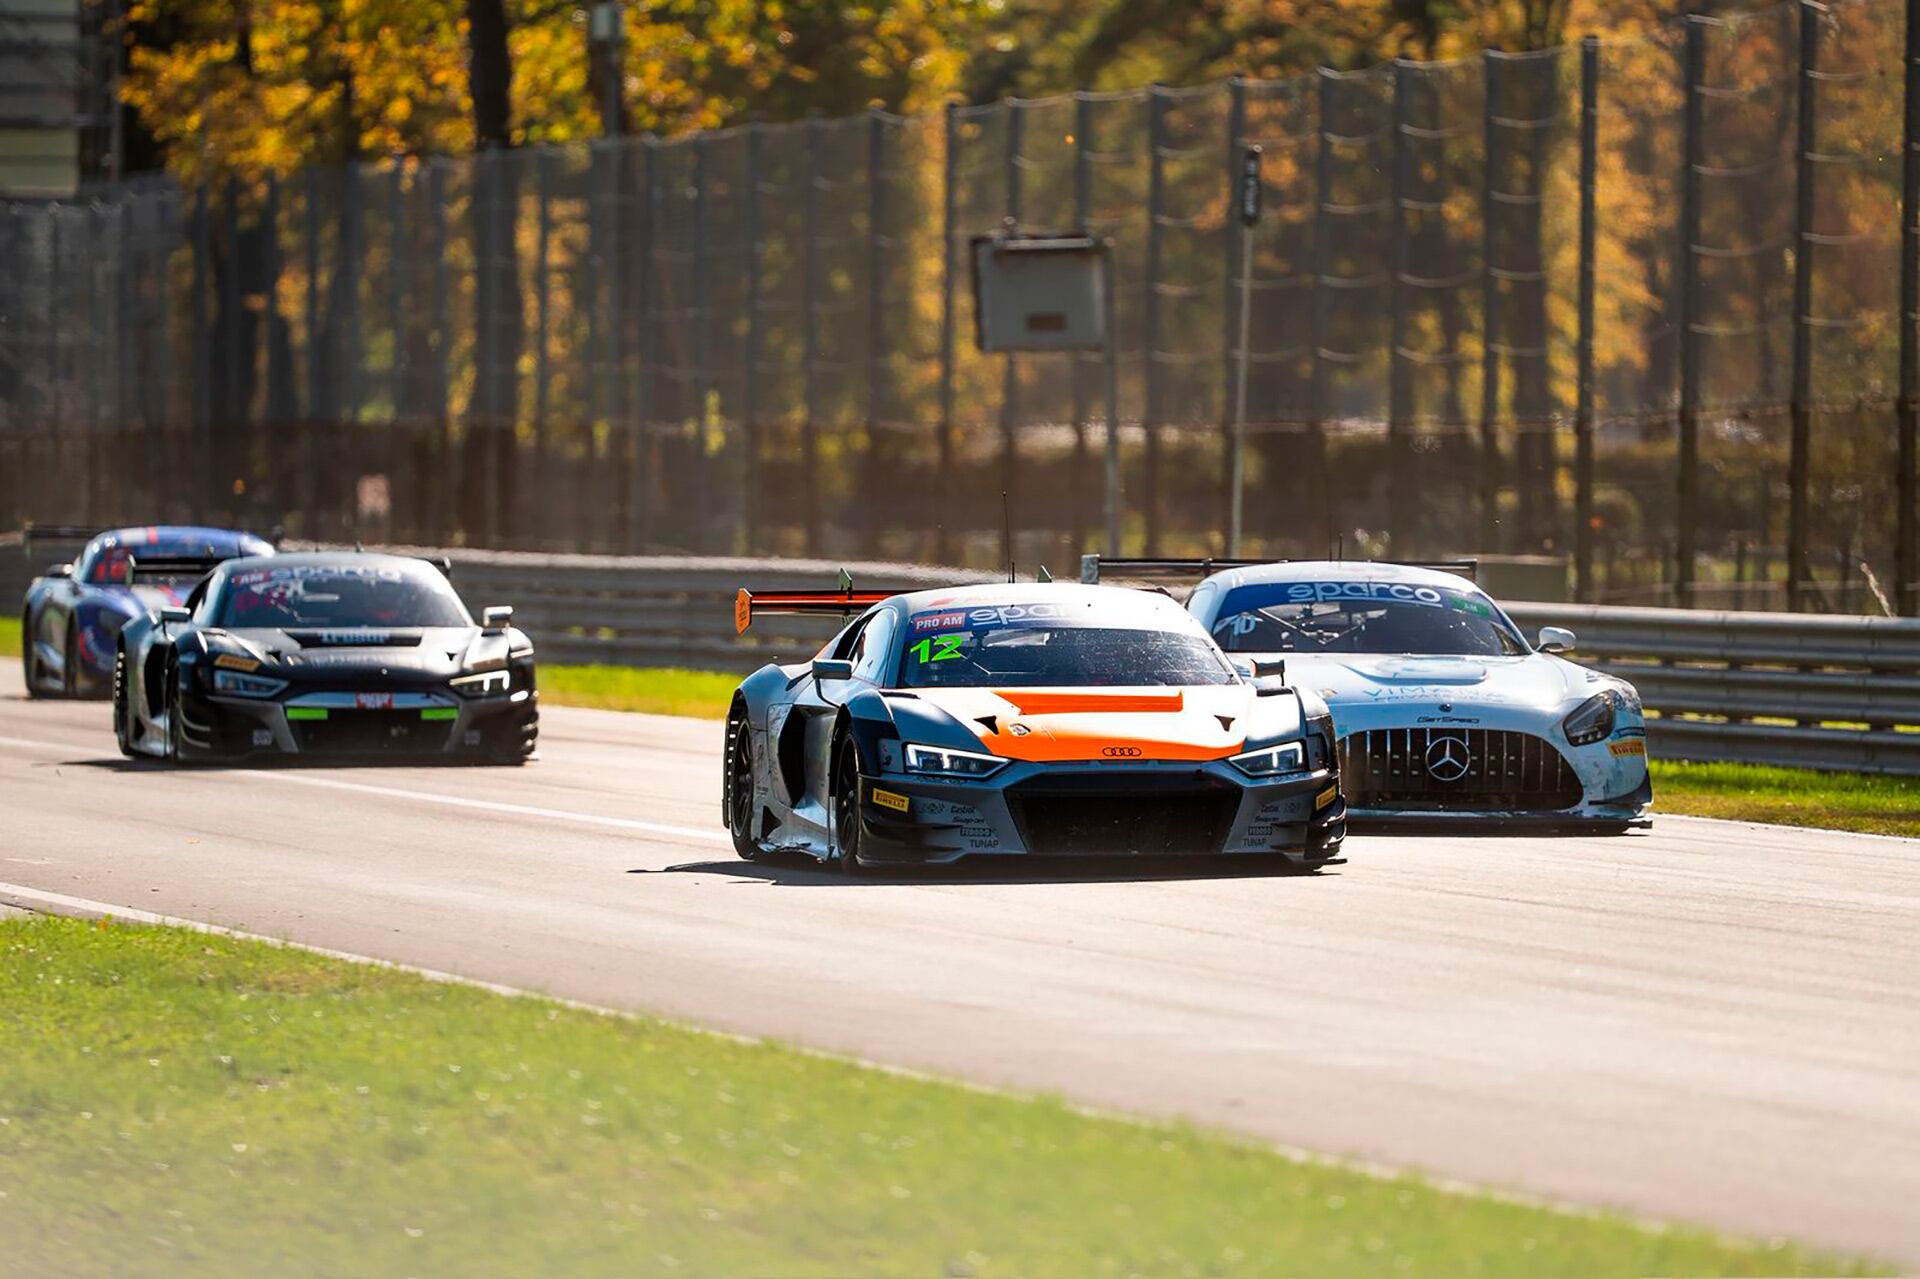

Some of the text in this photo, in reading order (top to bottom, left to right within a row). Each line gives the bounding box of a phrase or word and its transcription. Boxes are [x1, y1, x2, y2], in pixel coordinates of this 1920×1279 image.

[1287, 582, 1443, 603] sparco
[916, 616, 964, 630] PRO AM
[909, 635, 964, 665] 12
[876, 791, 906, 809] PIRELLI
[969, 839, 1000, 849] TUNAP
